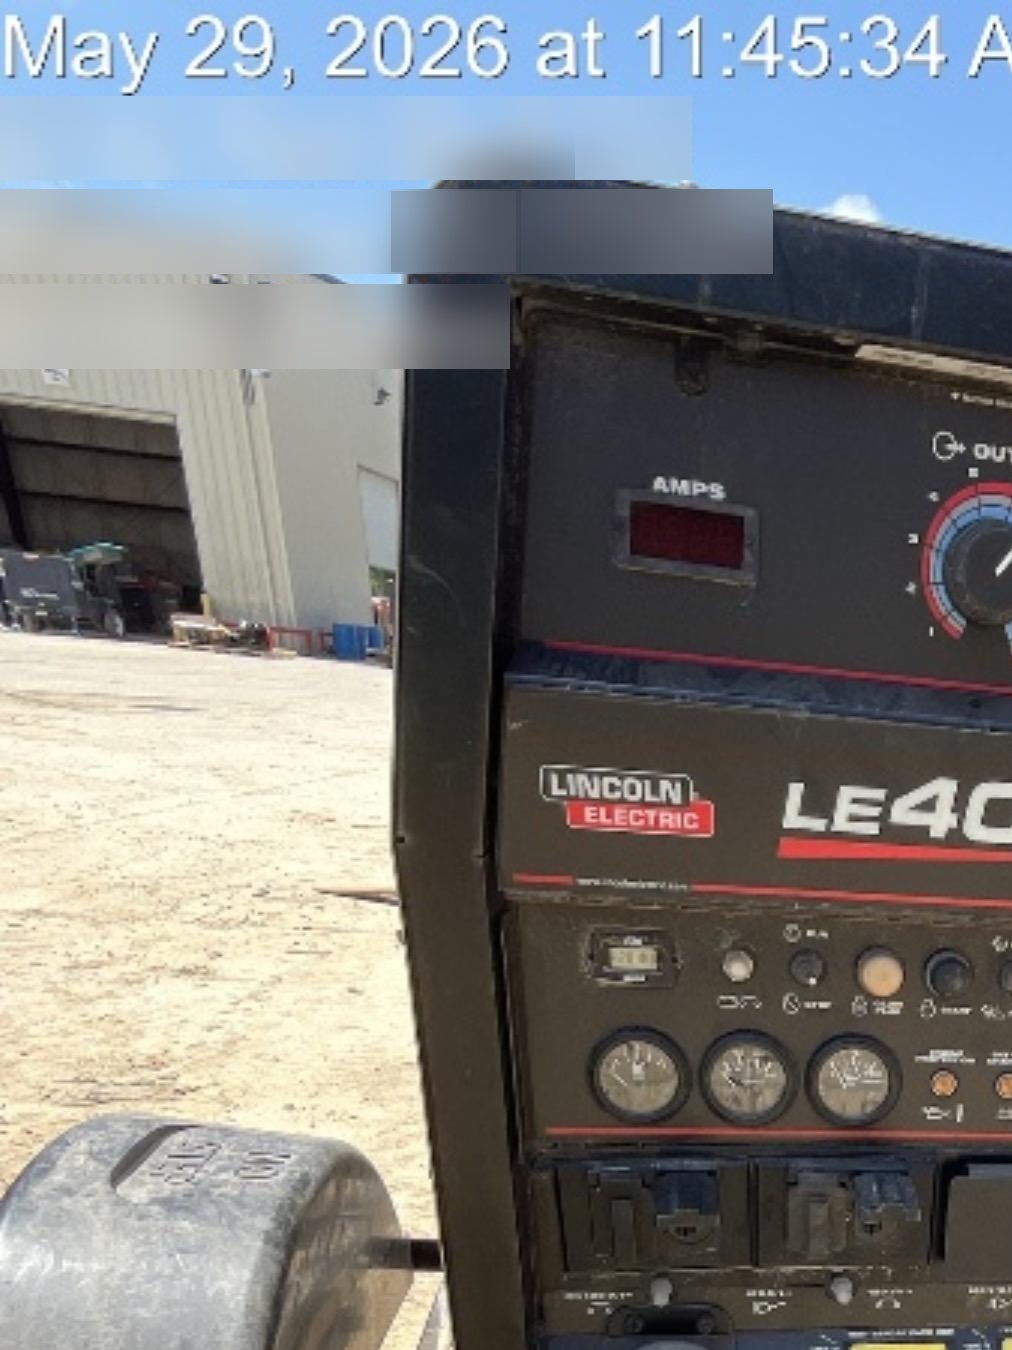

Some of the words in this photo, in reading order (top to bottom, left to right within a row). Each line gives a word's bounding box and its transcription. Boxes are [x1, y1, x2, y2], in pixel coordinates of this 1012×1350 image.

[653, 475, 727, 501] AMPS
[551, 772, 683, 806] LINCOLN
[583, 806, 700, 830] ELECTRIC
